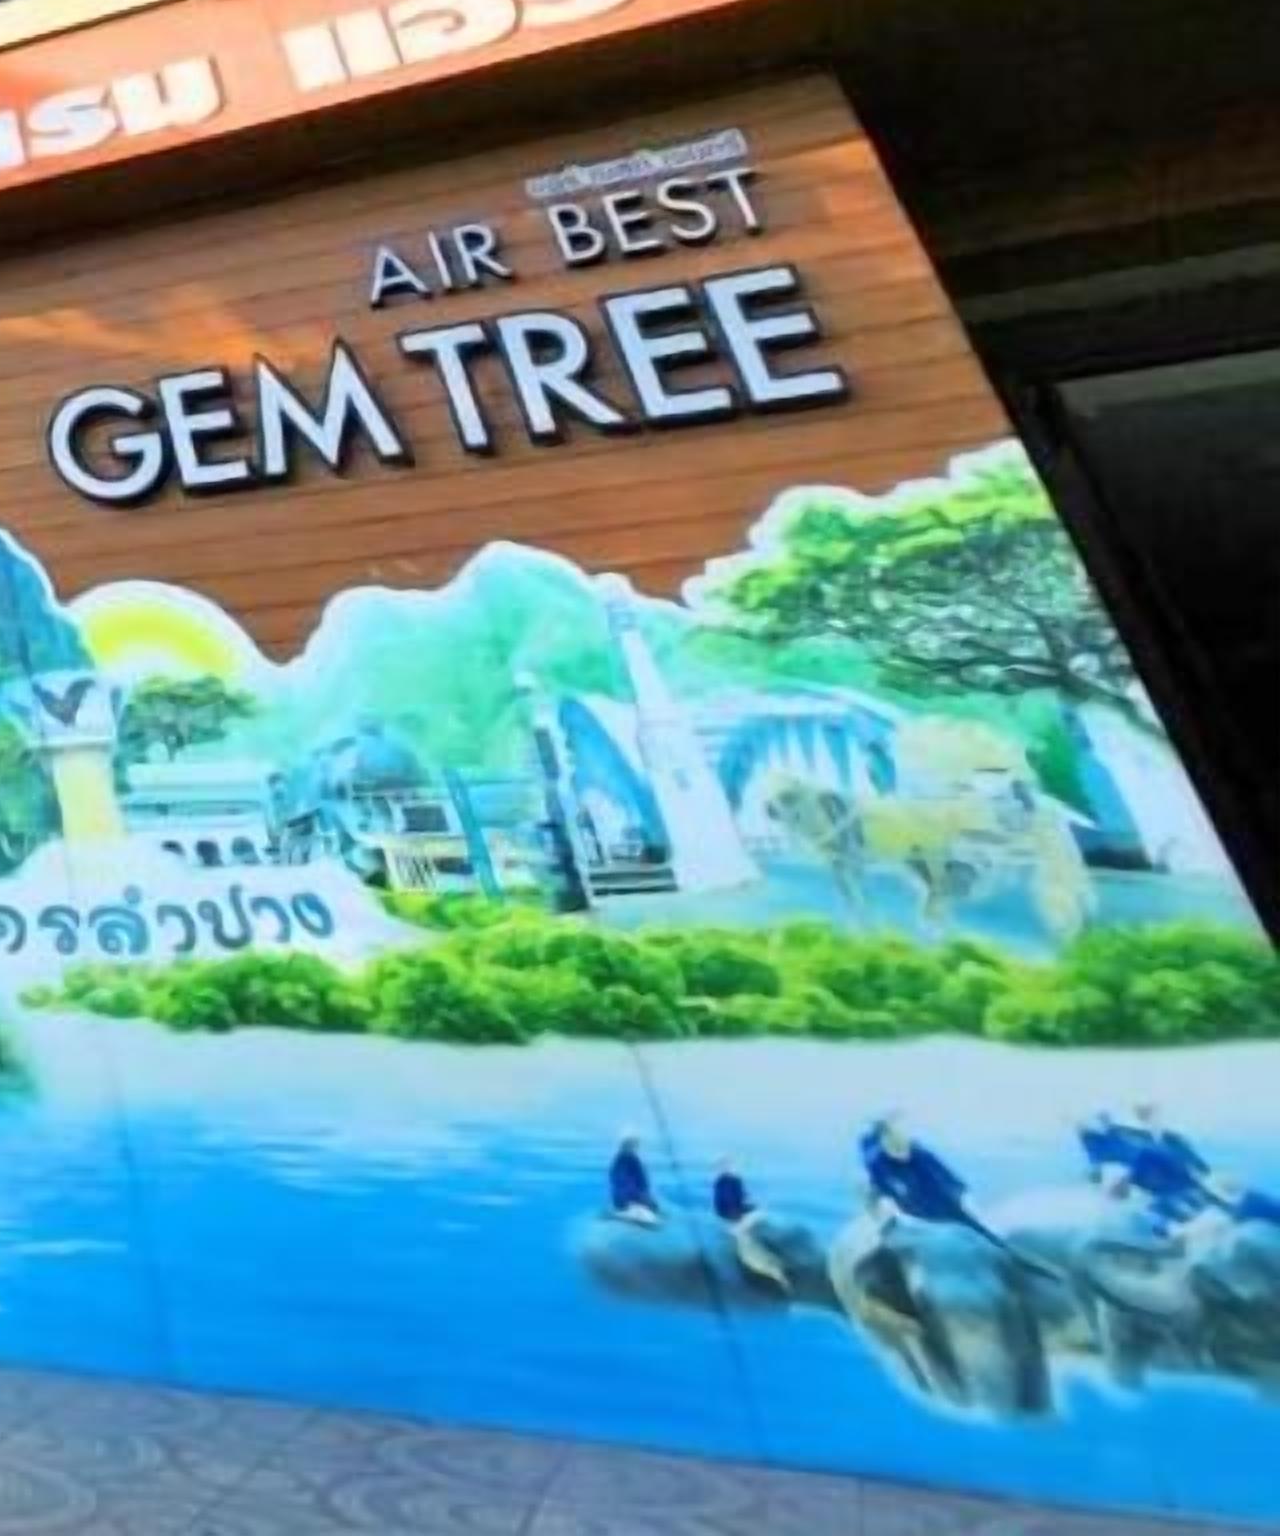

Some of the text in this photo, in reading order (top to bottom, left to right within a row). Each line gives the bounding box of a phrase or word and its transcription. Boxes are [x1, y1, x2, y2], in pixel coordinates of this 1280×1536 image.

[369, 166, 762, 308] AIR BEST
[46, 264, 850, 506] GEM TREE
